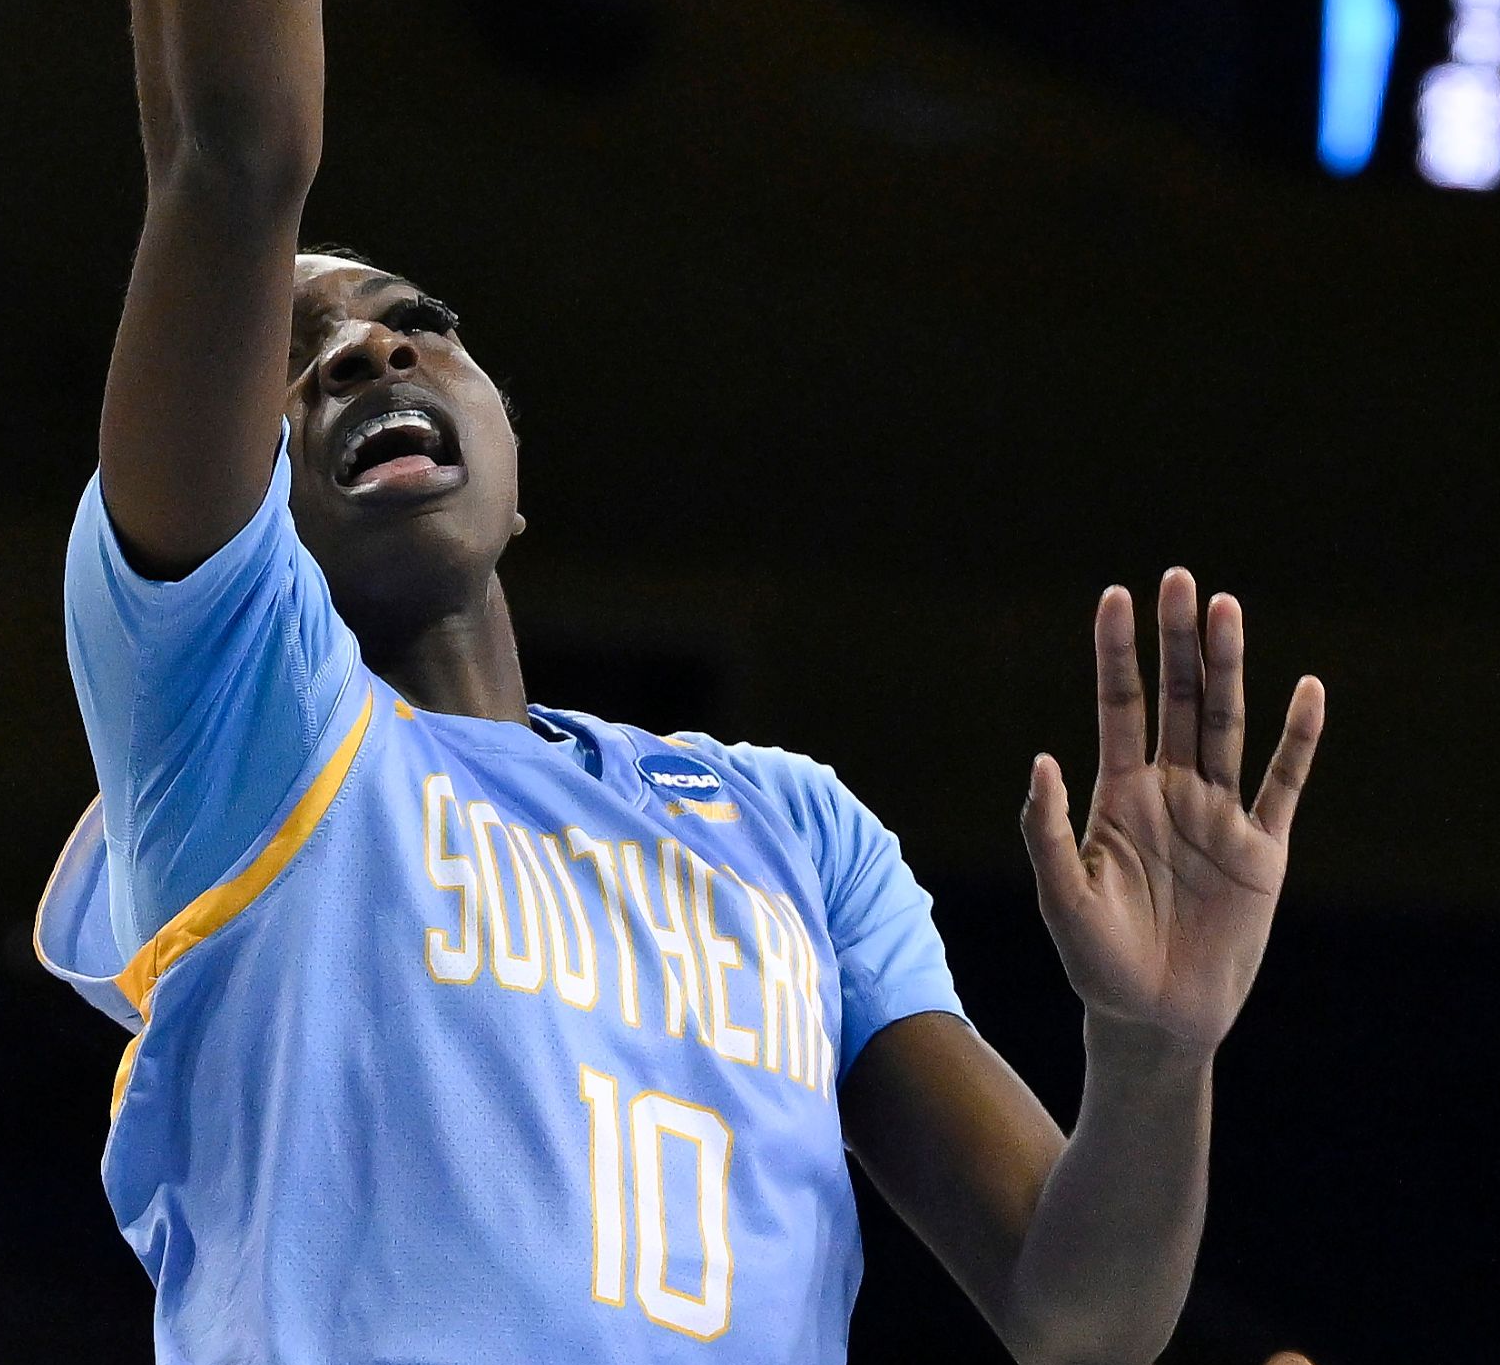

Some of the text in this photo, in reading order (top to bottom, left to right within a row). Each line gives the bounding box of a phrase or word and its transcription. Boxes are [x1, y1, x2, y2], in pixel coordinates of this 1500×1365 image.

[650, 771, 721, 789] NCAA
[422, 773, 835, 1101] SOUTHERN
[580, 1063, 735, 1343] 10
